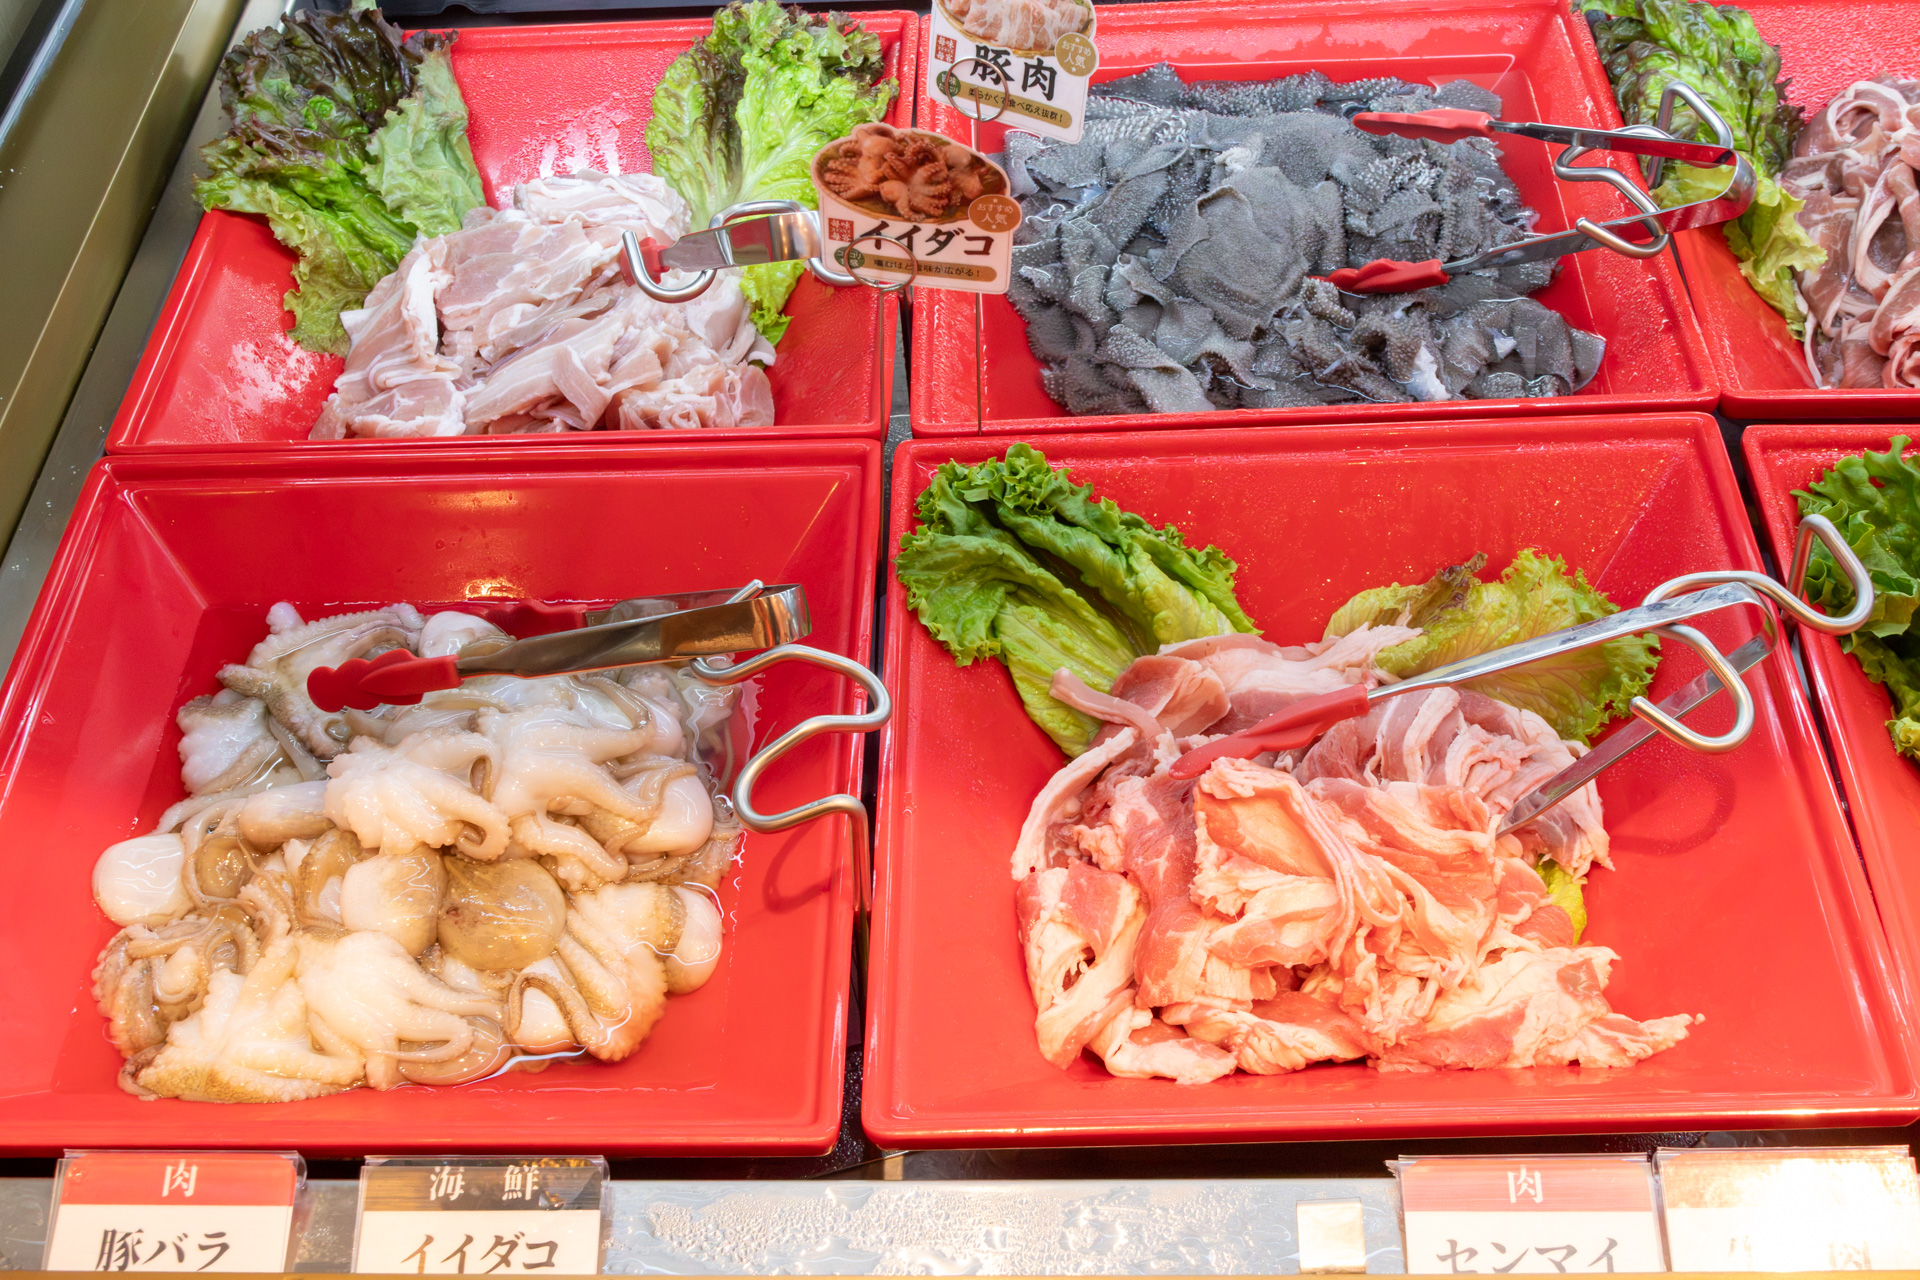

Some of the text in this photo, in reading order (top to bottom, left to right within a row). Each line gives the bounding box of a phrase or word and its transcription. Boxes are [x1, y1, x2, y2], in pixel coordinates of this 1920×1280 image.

[970, 45, 1057, 101] 豚肉
[1063, 52, 1086, 69] 人気
[981, 213, 1008, 225] 人気
[860, 220, 995, 256] イイダコ
[161, 1160, 199, 1198] 肉
[429, 1164, 540, 1201] 海鮮
[1507, 1164, 1544, 1204] 肉
[95, 1228, 231, 1271] 豚バラ
[400, 1231, 559, 1274] イイダコ
[1436, 1236, 1618, 1273] センマイ
